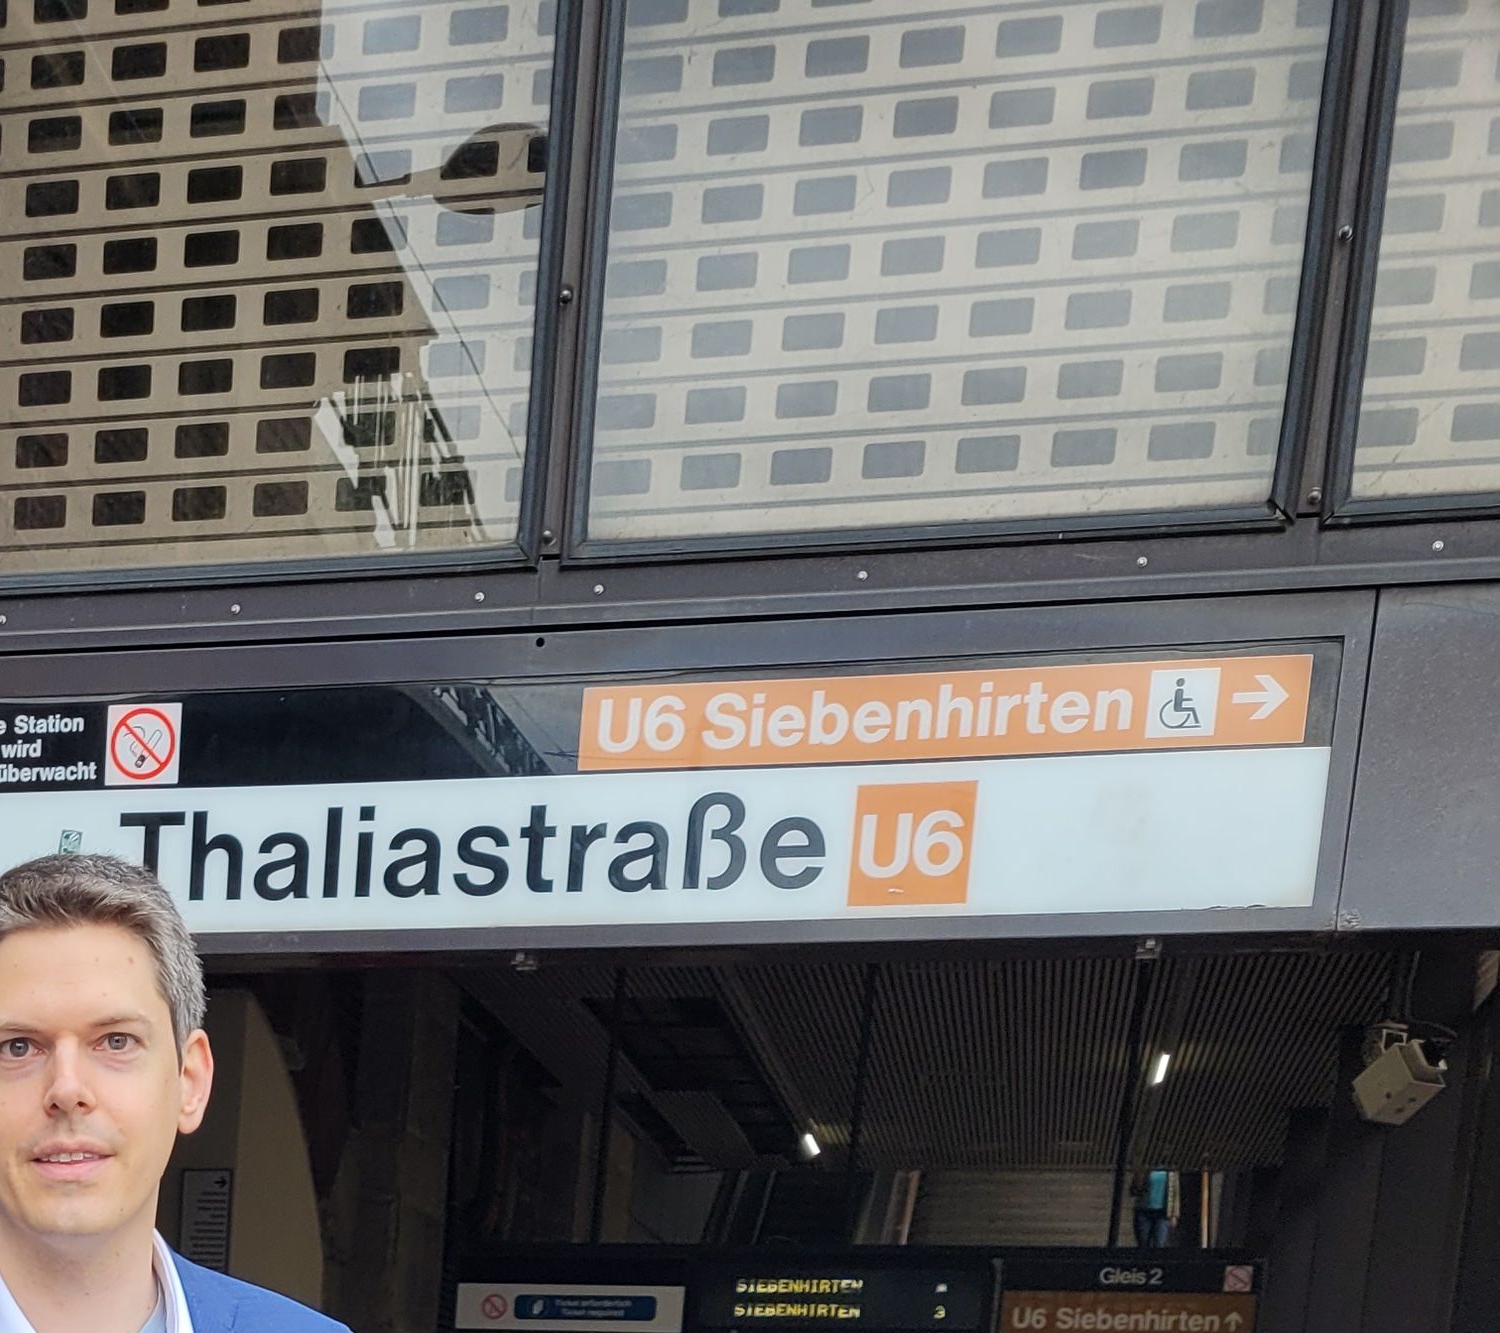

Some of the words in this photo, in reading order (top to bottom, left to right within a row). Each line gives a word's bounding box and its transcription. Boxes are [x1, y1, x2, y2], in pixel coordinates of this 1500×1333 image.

[13, 714, 85, 735] Station
[596, 694, 687, 755] U6
[700, 681, 1135, 752] Siebenhirten
[0, 739, 43, 759] wird
[119, 790, 827, 901] Thaliastraße
[858, 808, 965, 880] U6
[735, 1278, 864, 1294] SIEBENHIRTEN
[1099, 1267, 1147, 1285] Gleis
[1149, 1268, 1164, 1285] 2
[733, 1303, 861, 1319] SIEBENHIRTEN
[1011, 1306, 1048, 1330] U6
[1055, 1306, 1221, 1333] Siebenhirten
